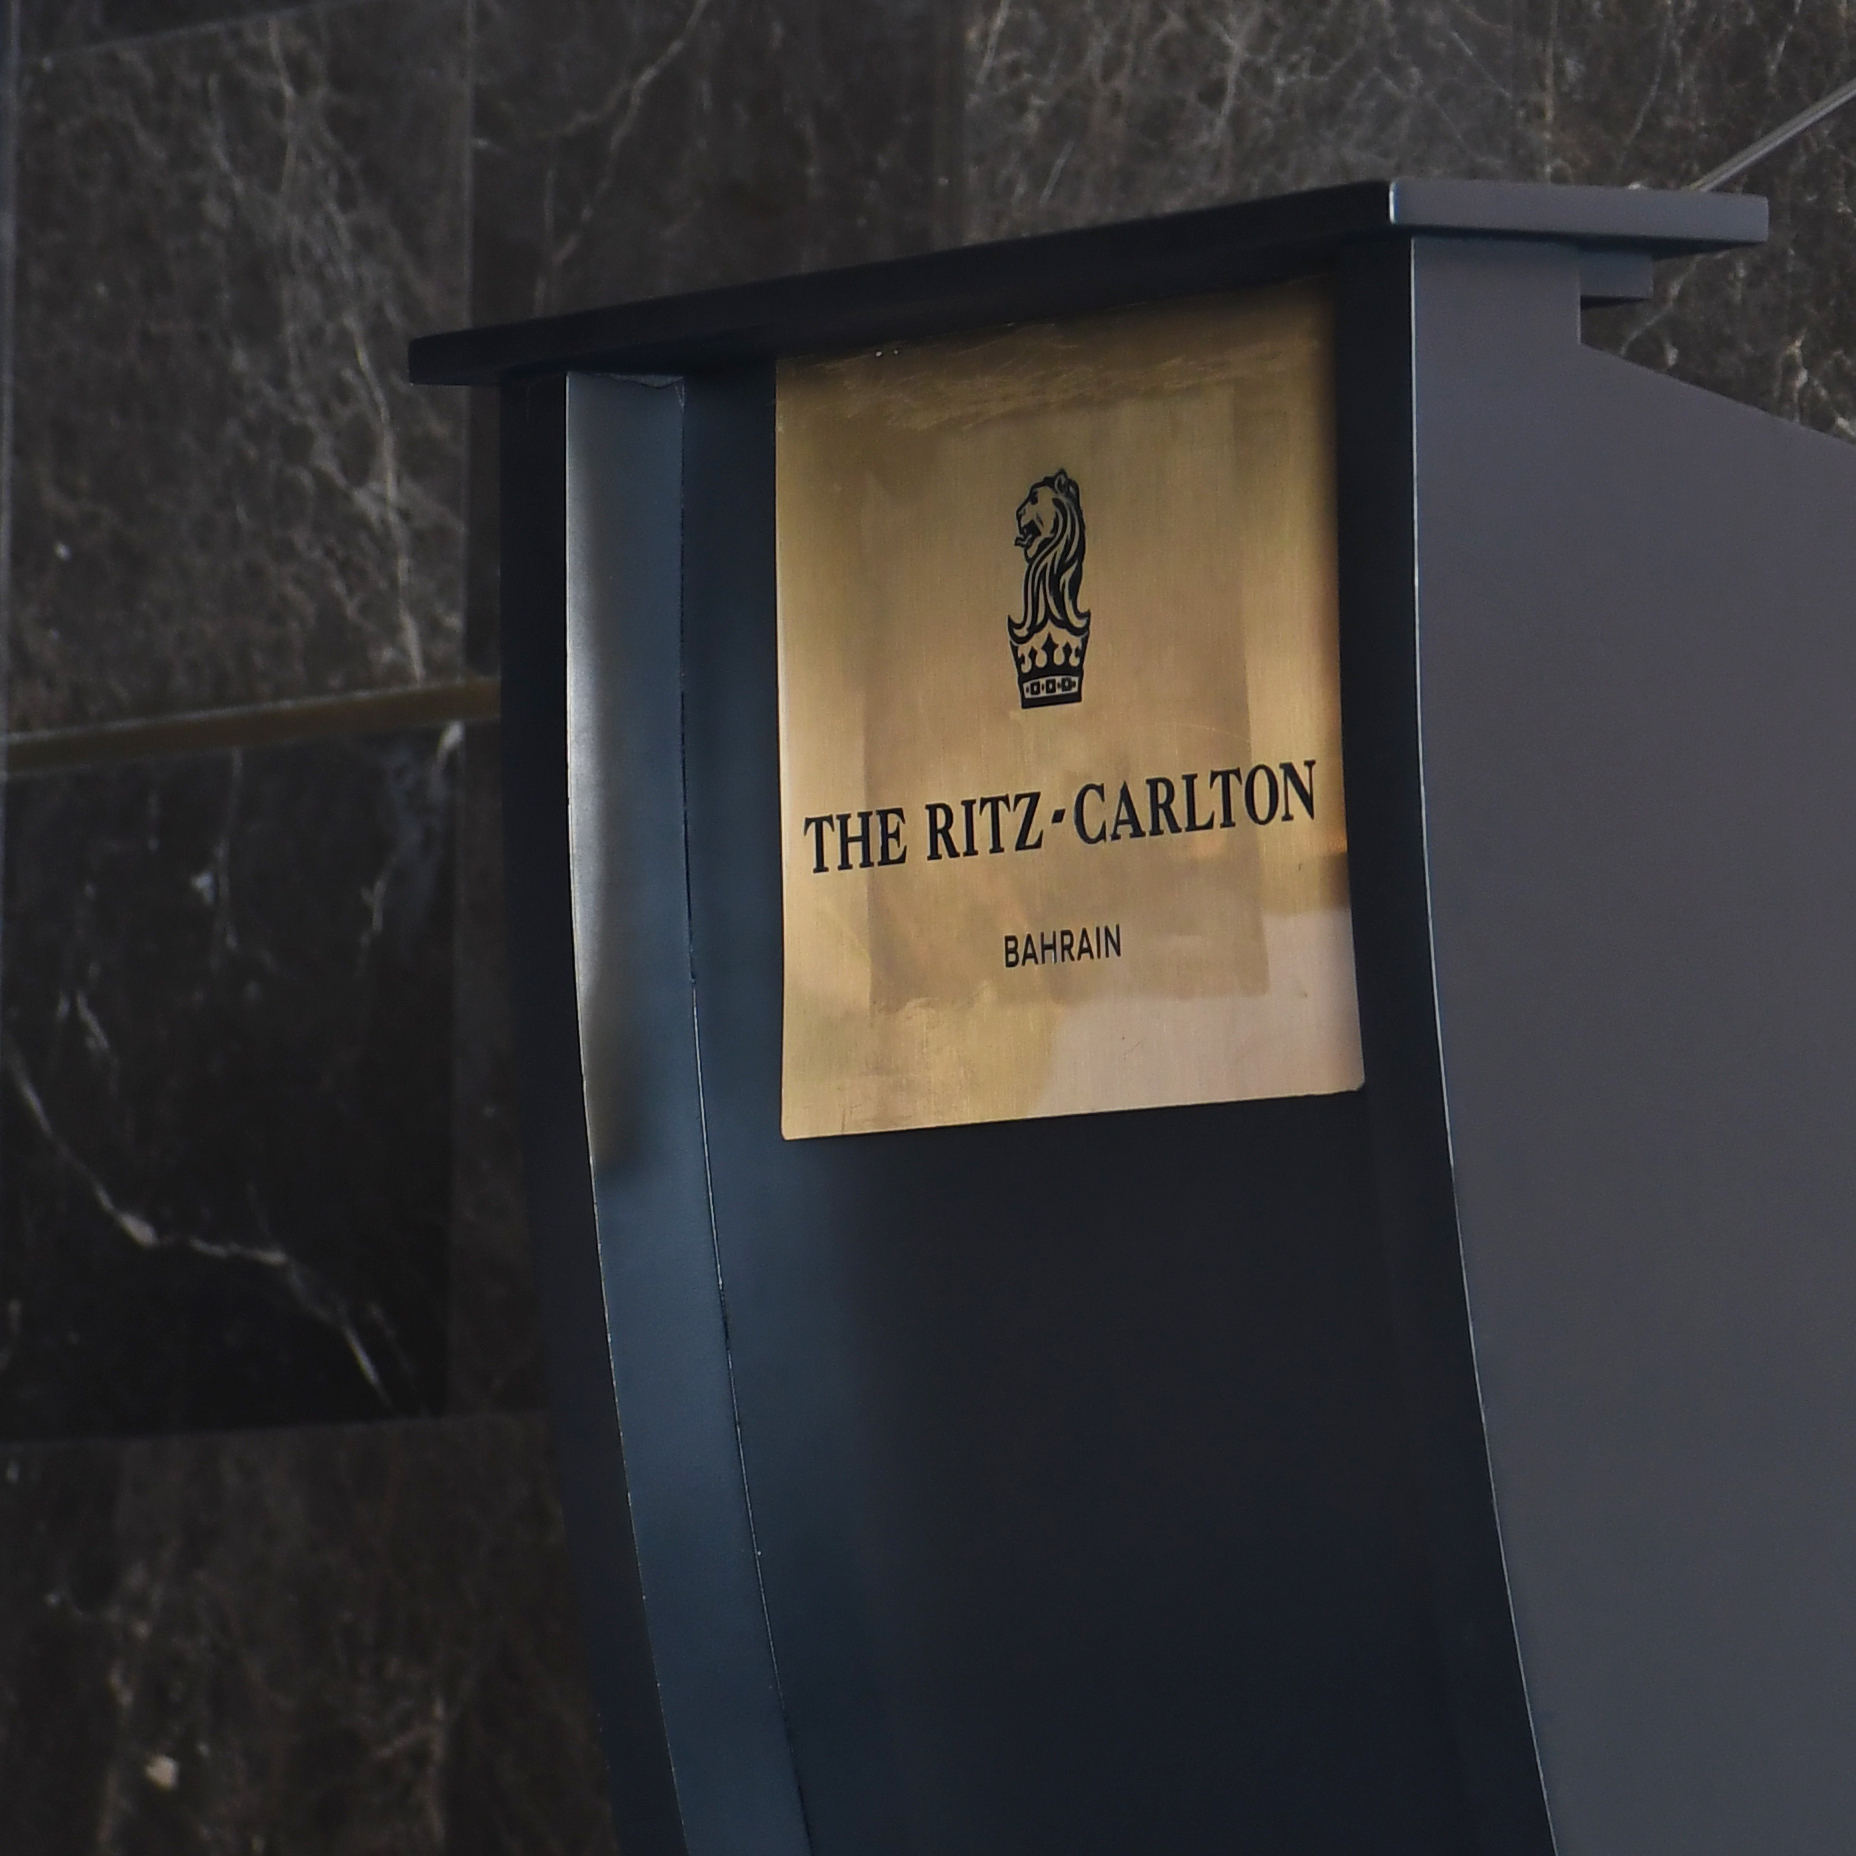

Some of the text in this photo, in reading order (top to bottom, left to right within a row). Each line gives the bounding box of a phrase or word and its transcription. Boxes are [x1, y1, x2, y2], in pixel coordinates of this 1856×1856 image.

[803, 759, 1317, 874] THE RITZ-CARLTON
[1004, 924, 1122, 968] BAHRAIN
